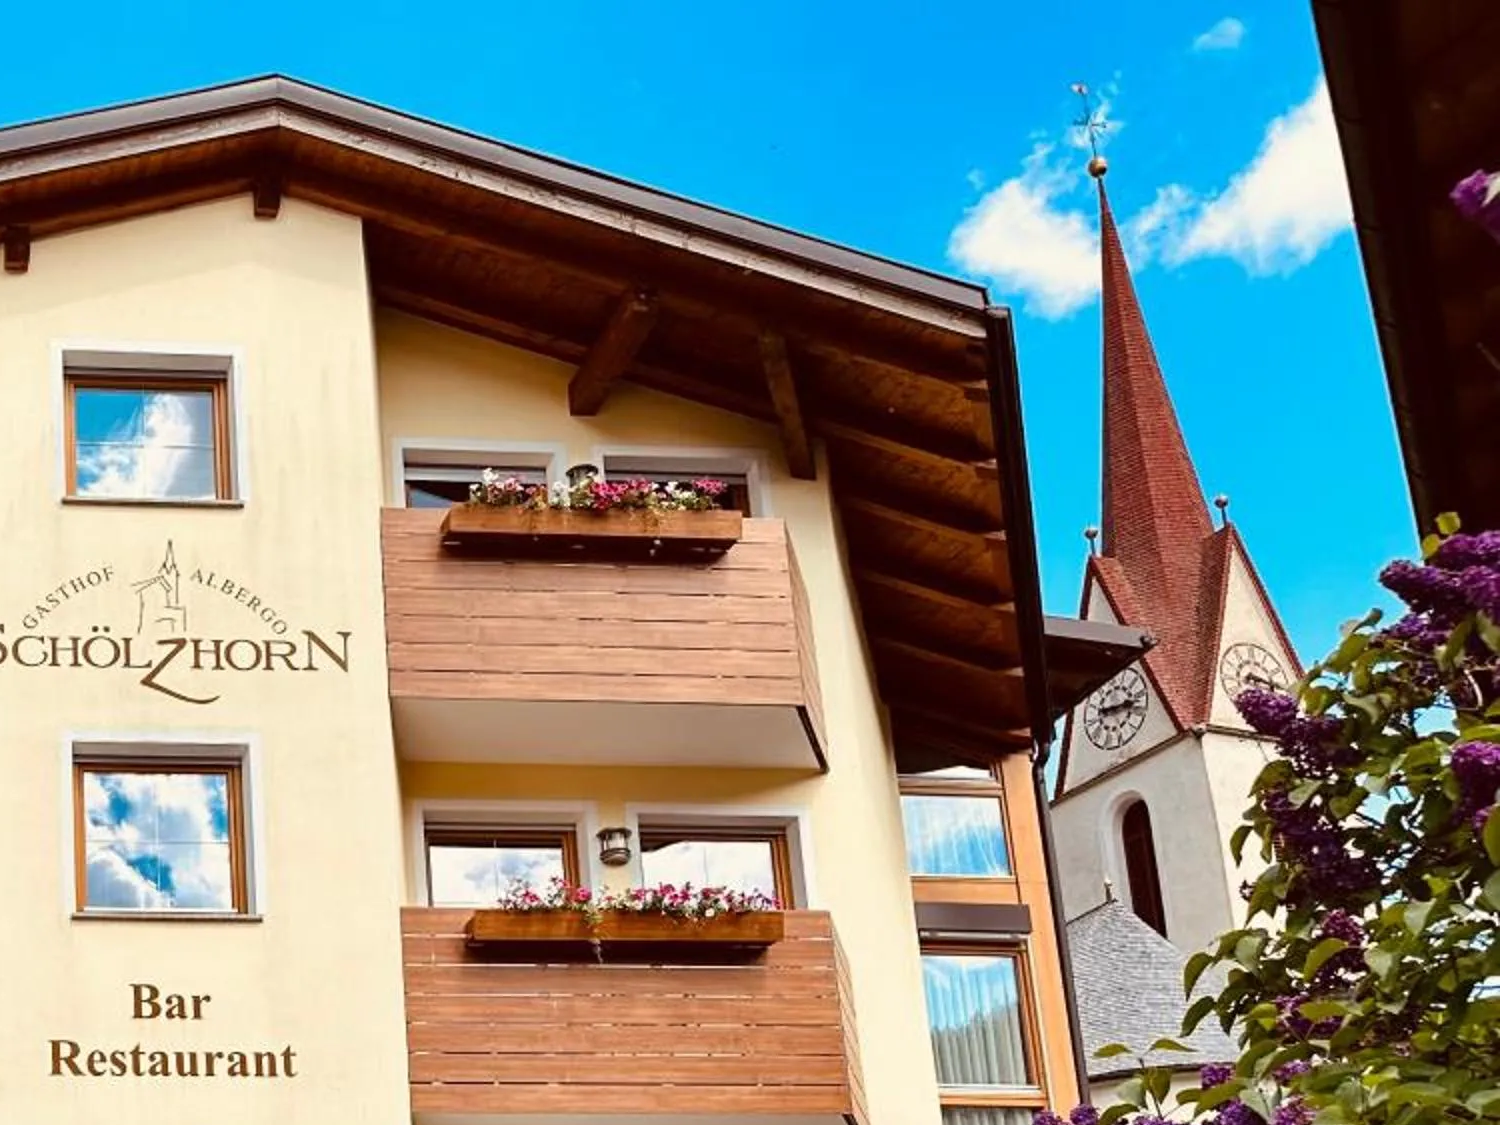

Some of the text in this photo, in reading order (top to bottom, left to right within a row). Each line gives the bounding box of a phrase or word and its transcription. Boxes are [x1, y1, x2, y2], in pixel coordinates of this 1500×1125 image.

[22, 566, 288, 636] GASTHOF ALBERGO
[128, 983, 212, 1021] Bar
[47, 1039, 298, 1079] Restaurant
